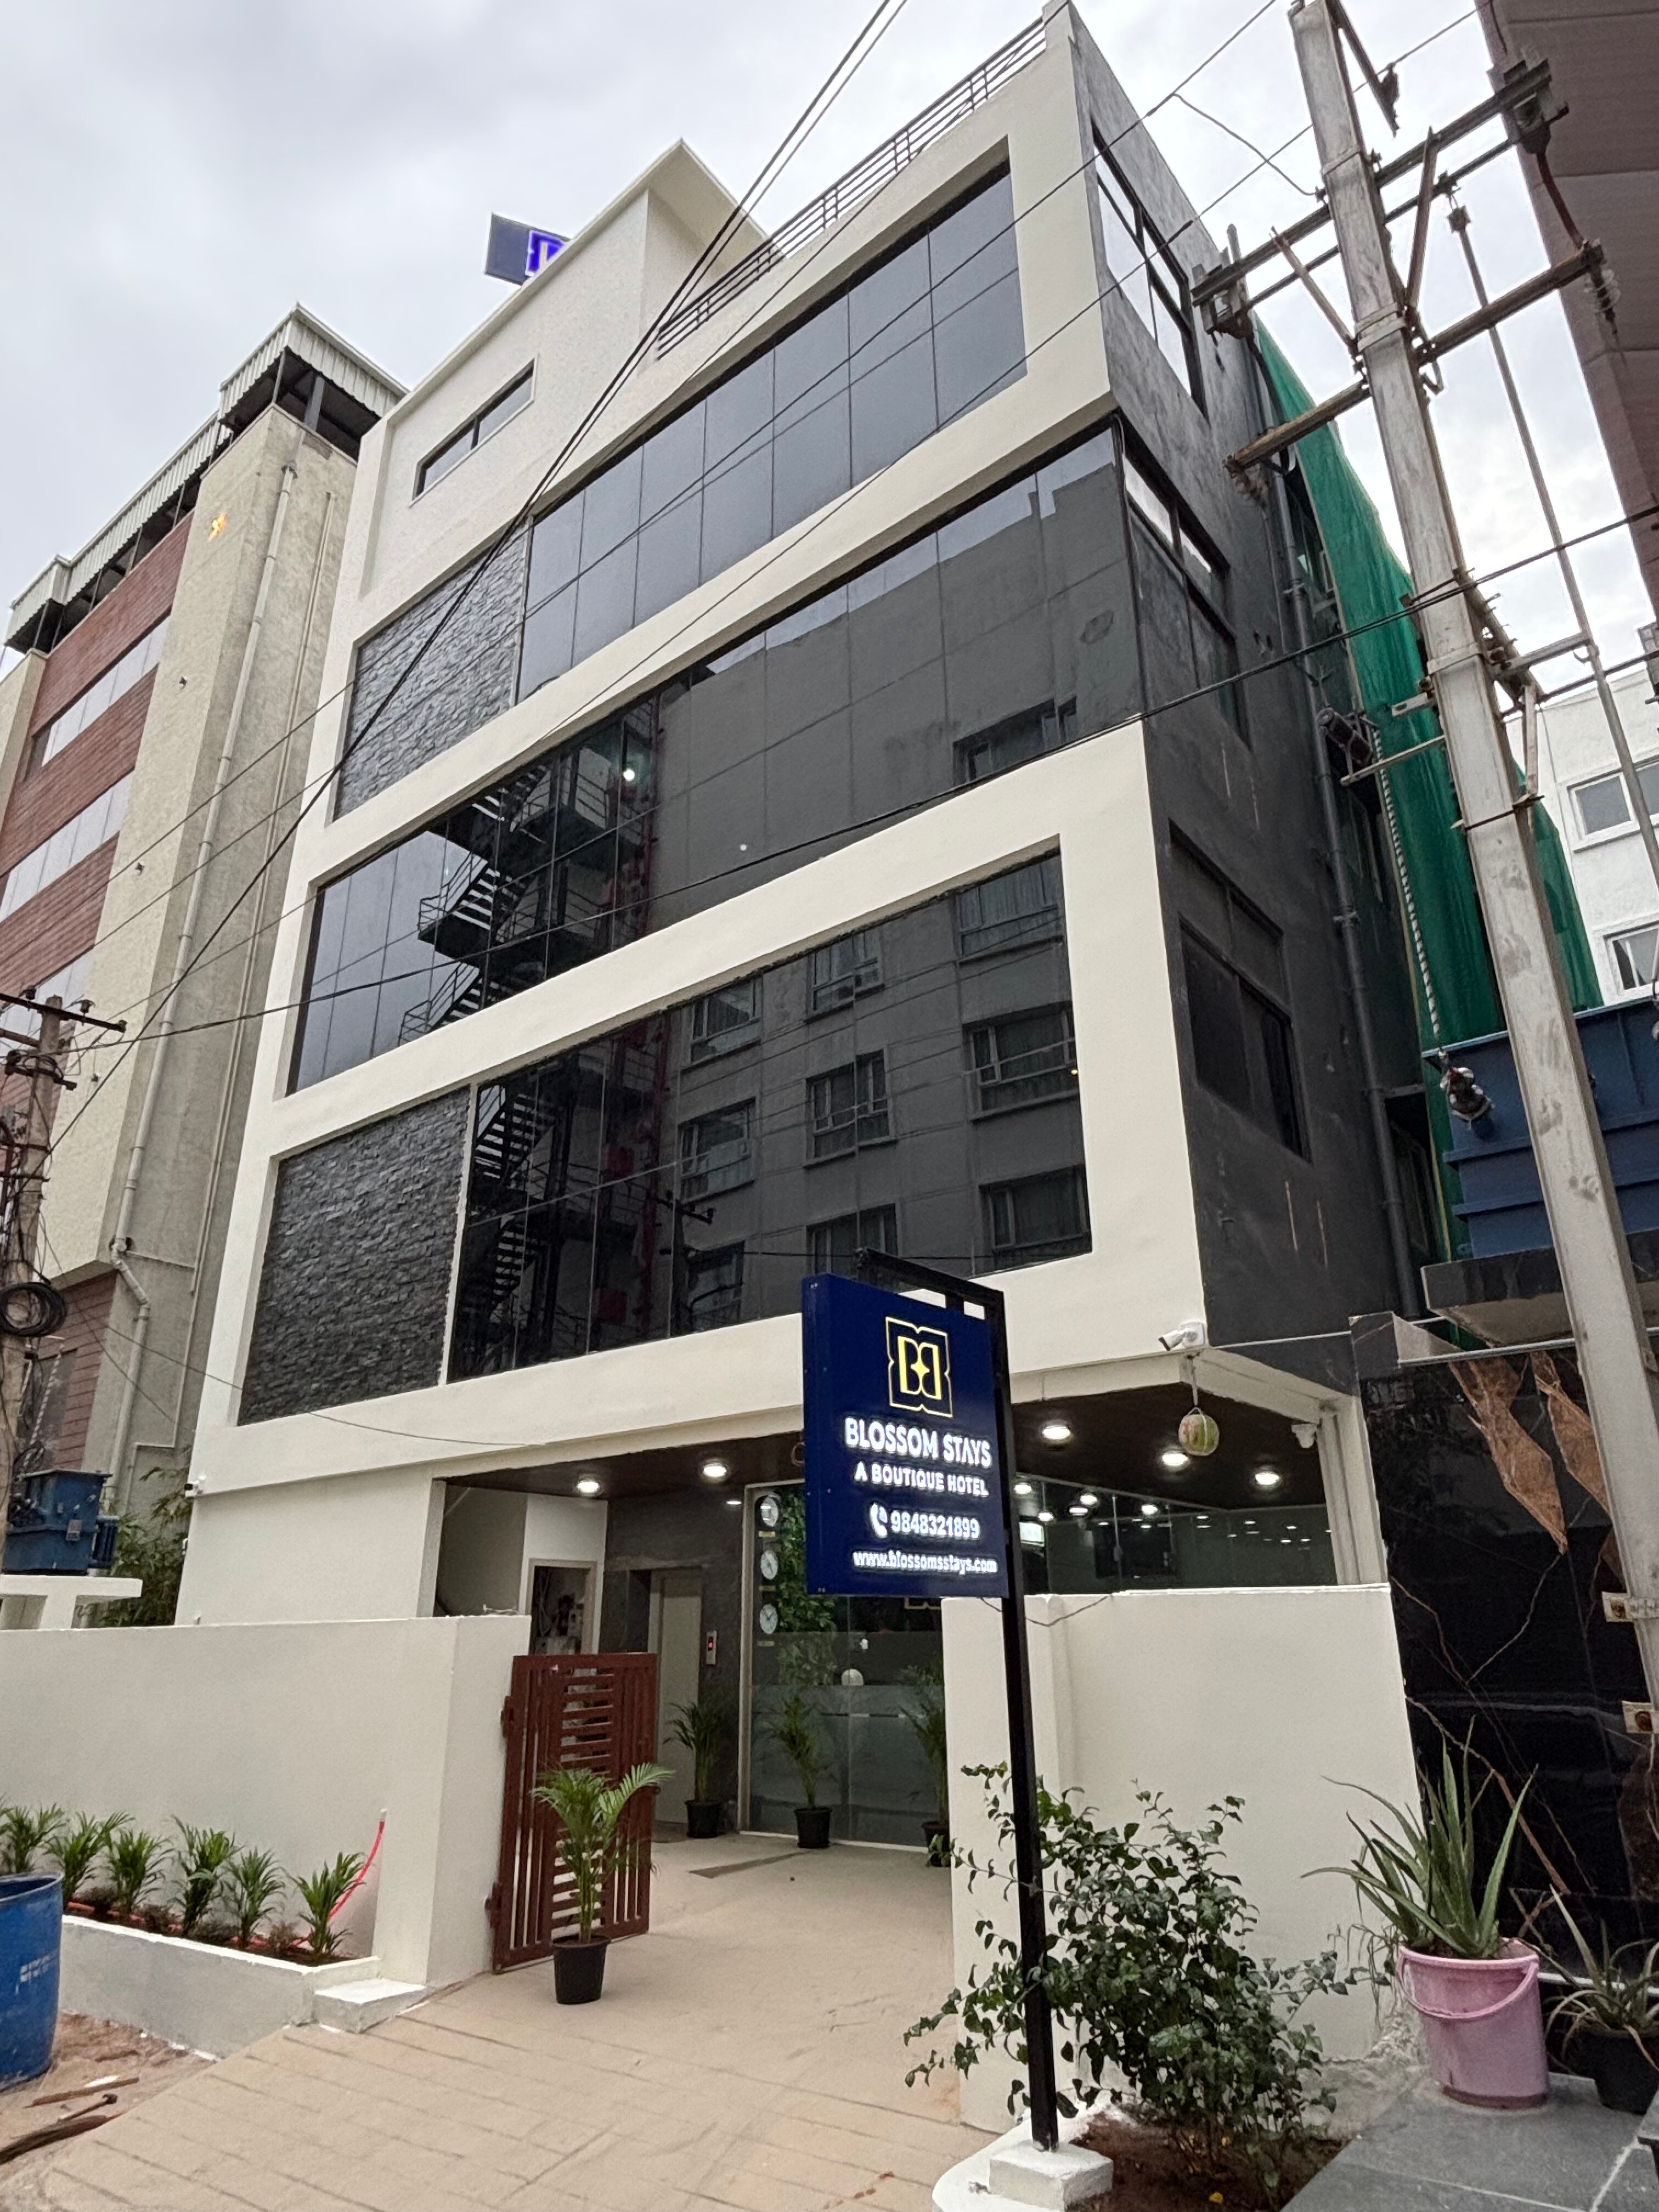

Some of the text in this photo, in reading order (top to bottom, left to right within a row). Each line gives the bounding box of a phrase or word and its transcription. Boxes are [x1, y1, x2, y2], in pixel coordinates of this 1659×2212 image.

[845, 1417, 992, 1469] BLOSSOM STAYS
[854, 1462, 990, 1497] A BOUTIQUE HOTEL
[890, 1510, 980, 1539] 9848321899
[853, 1549, 998, 1576] www.blossomsstays.com
